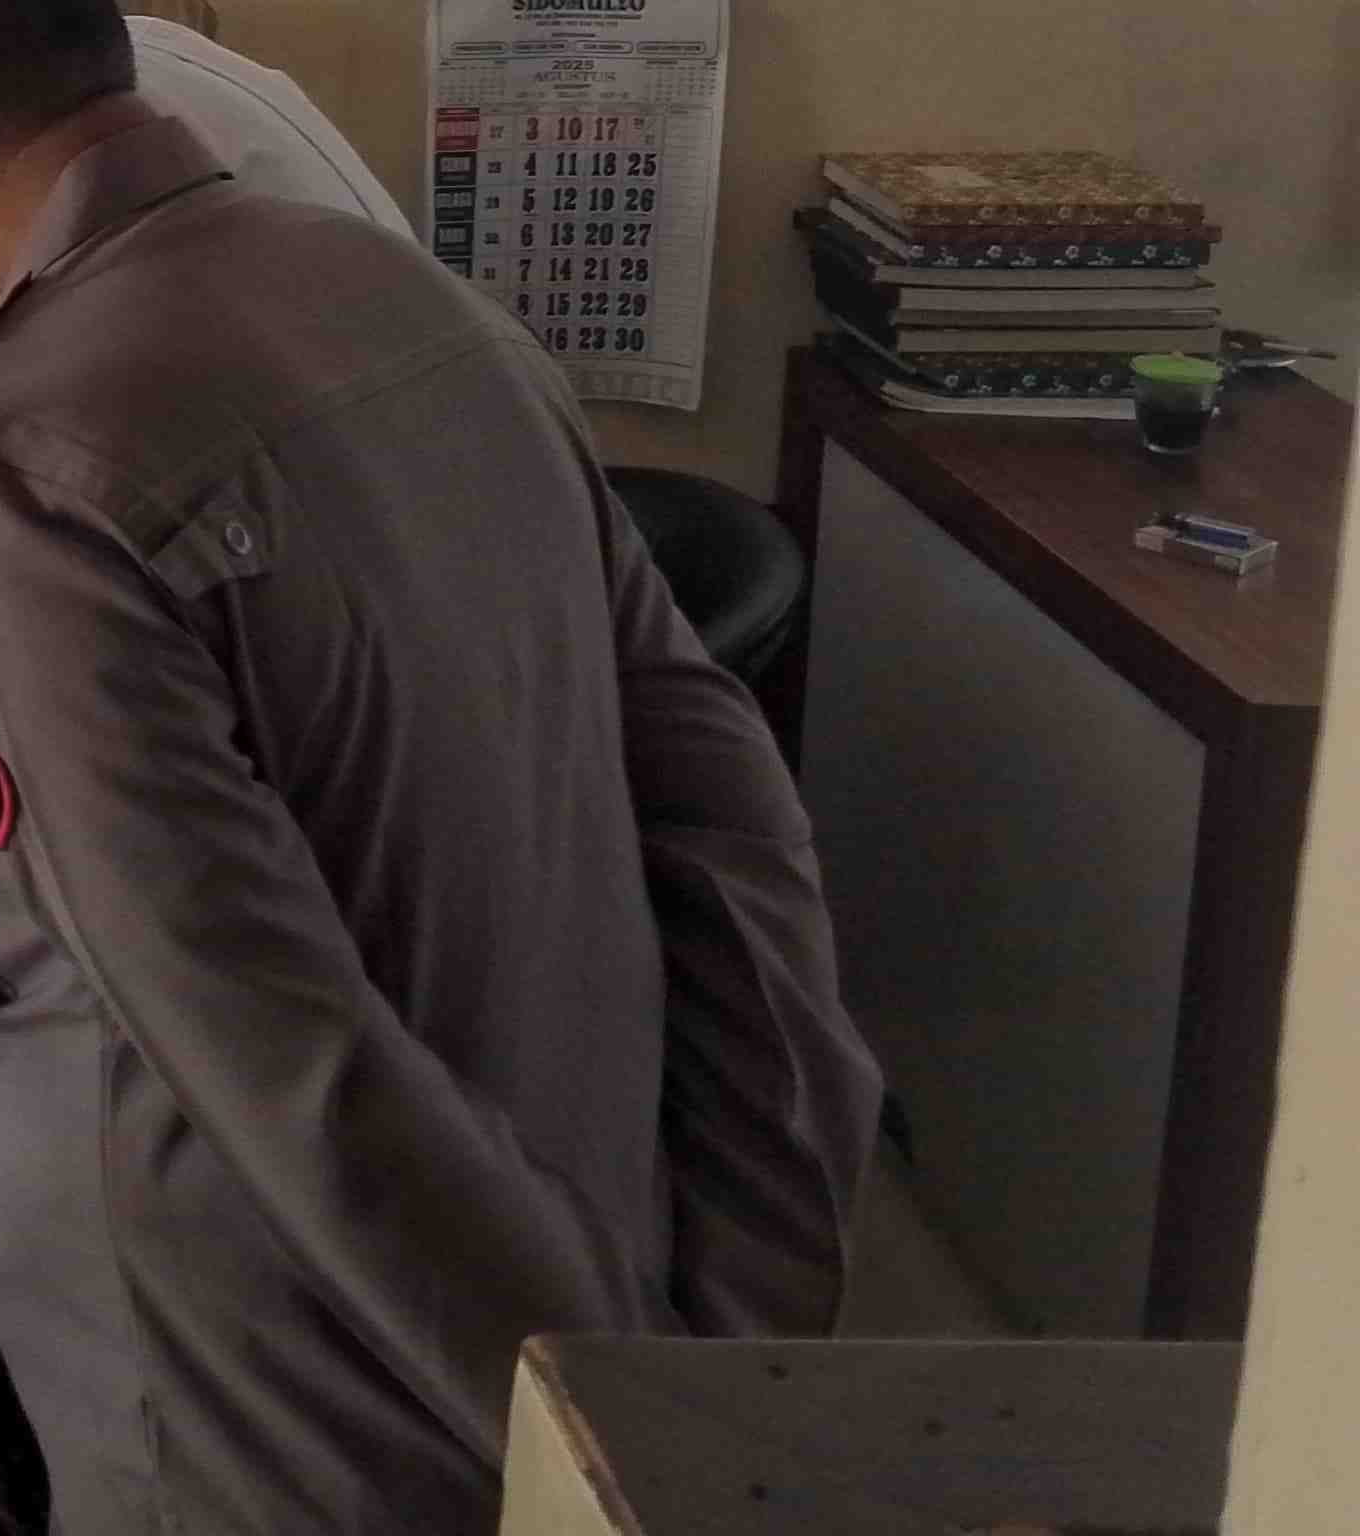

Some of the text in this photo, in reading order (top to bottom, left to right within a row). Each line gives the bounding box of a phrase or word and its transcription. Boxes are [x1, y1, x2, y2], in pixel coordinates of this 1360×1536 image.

[533, 71, 617, 82] AGUSTUS
[552, 60, 594, 70] 2025
[526, 117, 539, 141] 3
[556, 117, 582, 141] 10
[593, 117, 619, 141] 17
[524, 152, 537, 176] 4
[556, 152, 578, 176] 11
[592, 152, 616, 176] 18
[627, 152, 657, 177] 25
[522, 188, 535, 212] 5
[553, 187, 577, 212] 12
[589, 187, 614, 212] 19
[625, 187, 655, 212] 26
[520, 223, 533, 247] 6
[550, 222, 575, 247] 13
[584, 222, 613, 246] 20
[622, 223, 652, 247] 27
[520, 259, 532, 282] 7
[548, 258, 571, 282] 14
[584, 258, 609, 281] 21
[620, 258, 648, 282] 28
[518, 292, 647, 317] 8 15 22 29
[545, 327, 644, 352] 16 23 30
